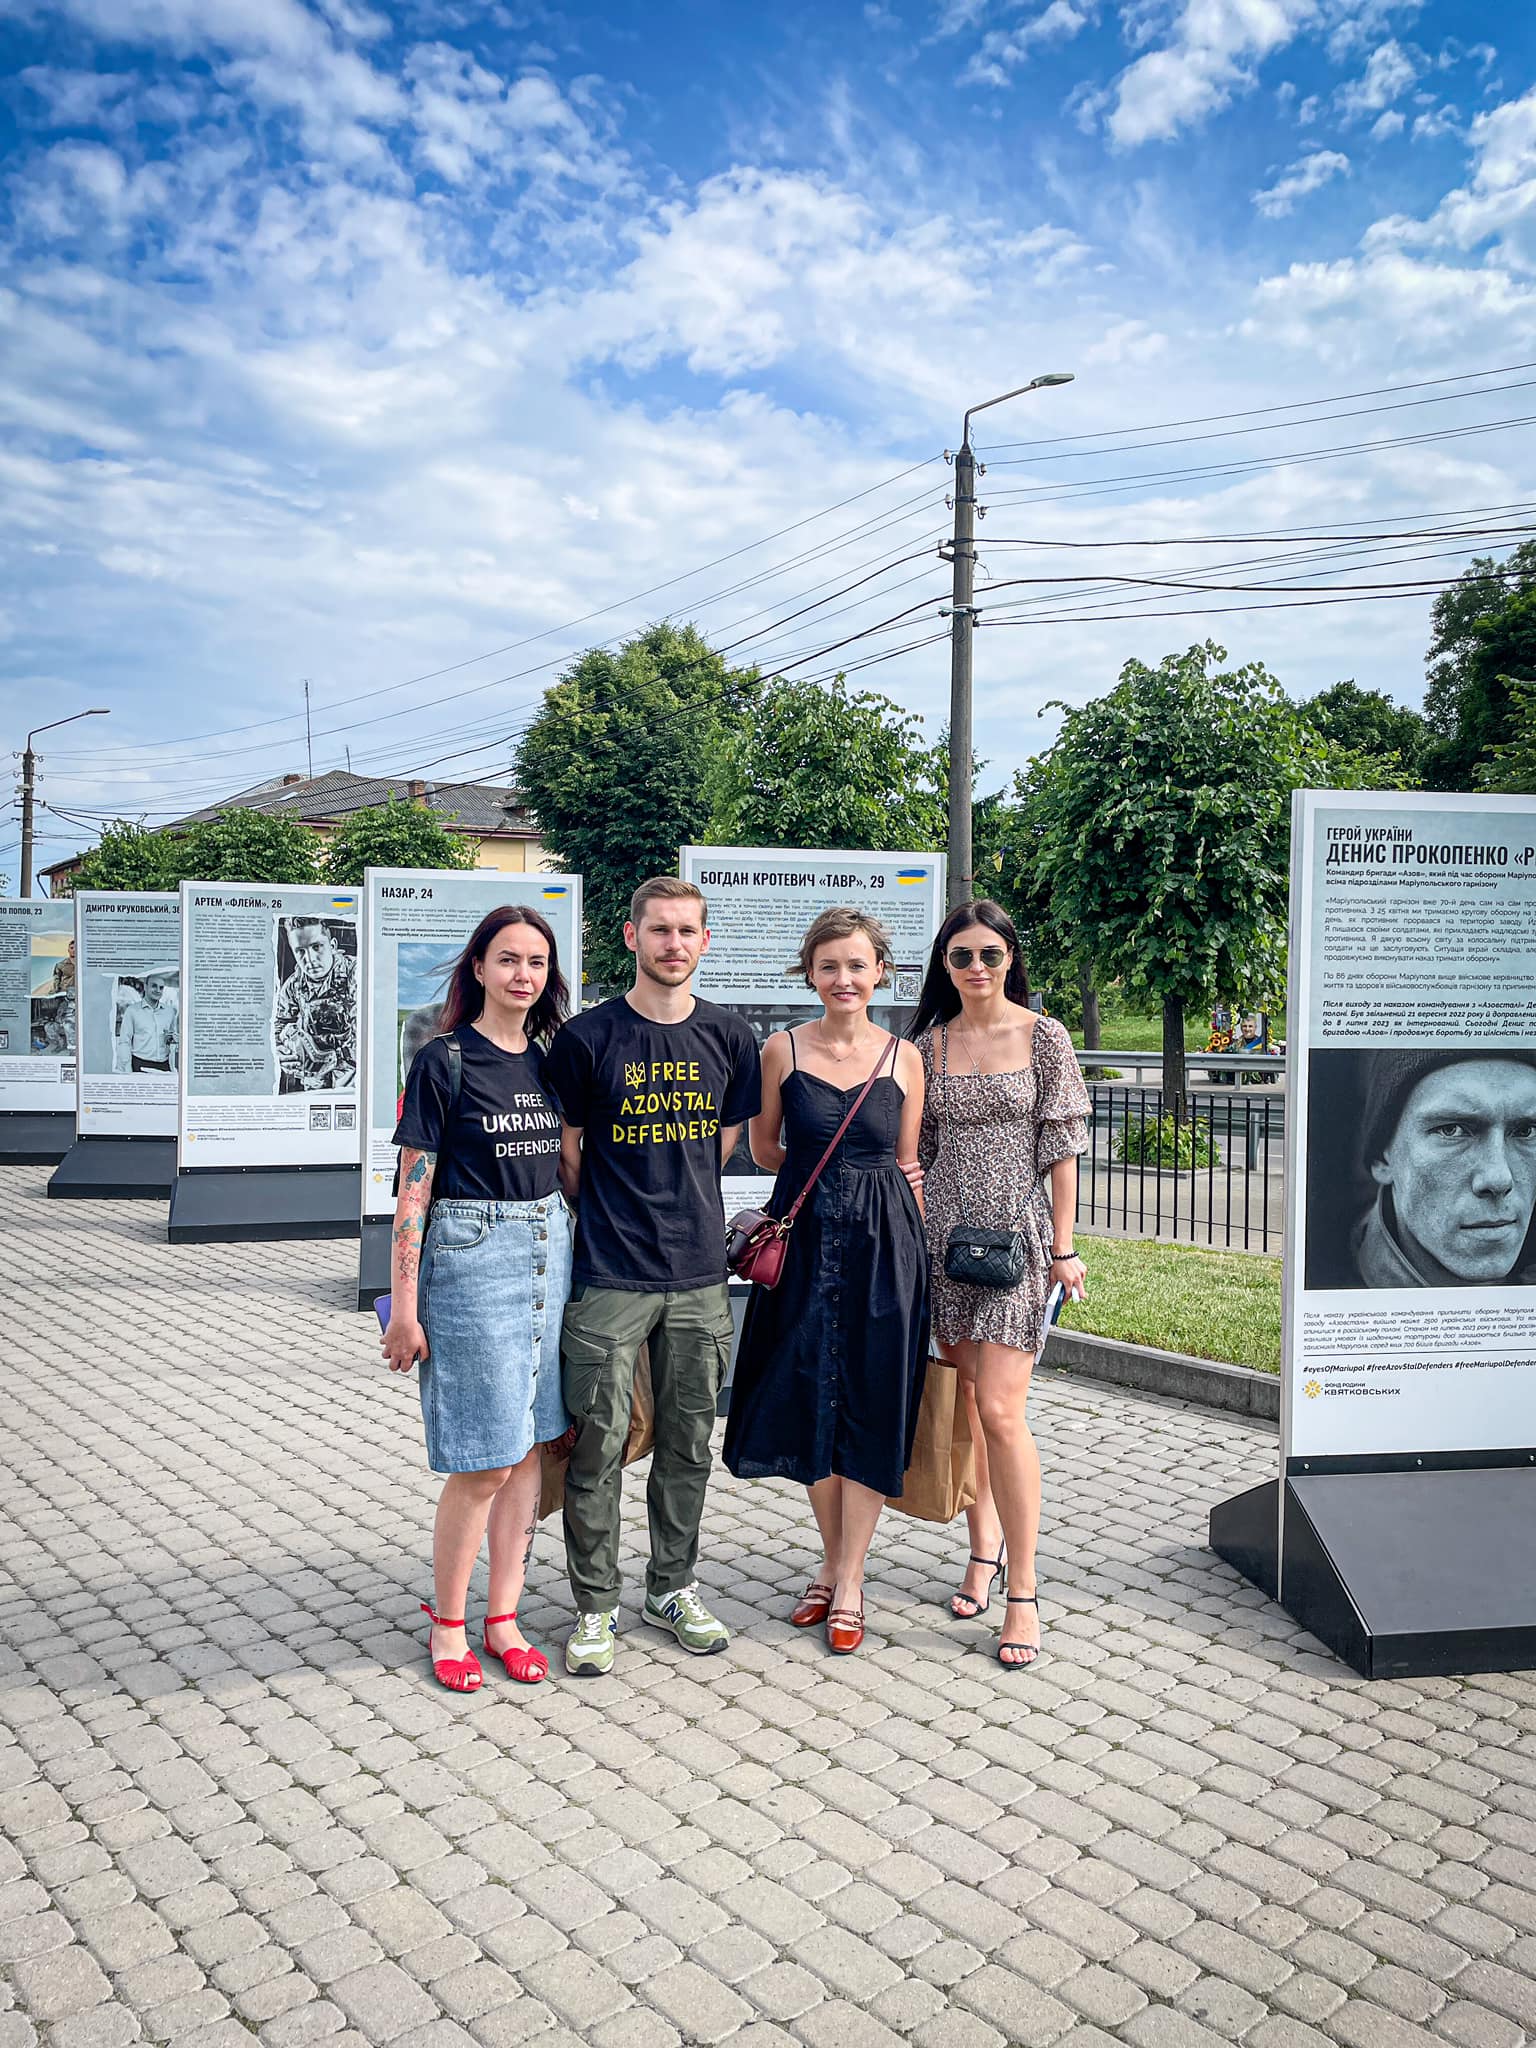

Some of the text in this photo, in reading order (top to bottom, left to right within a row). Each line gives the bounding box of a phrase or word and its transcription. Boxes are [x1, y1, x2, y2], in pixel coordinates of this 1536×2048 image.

[1327, 826, 1412, 842] ГЕРОЙ УКРАЇНИ
[1326, 843, 1536, 866] ДЕНИС ПРОКОПЕНКО «Р
[701, 871, 884, 889] БОГДАН КРОТЕВИЧ «ТАВР», 29
[1326, 869, 1364, 878] Командир
[1366, 869, 1396, 878] бригади
[1448, 870, 1459, 878] під
[1474, 871, 1505, 879] оборони
[1348, 879, 1397, 887] підрозділами
[1399, 880, 1462, 888] Маріупольського
[1463, 880, 1498, 889] гарнізону
[382, 887, 432, 900] НАЗАР, 24
[86, 904, 115, 913] ДМИТРО
[117, 904, 171, 914] КРУКОВСЬКИЙ,
[195, 897, 282, 909] АРТЕМ «ФЛЕЙМ», 26
[1345, 1000, 1371, 1009] виходу
[1417, 1001, 1470, 1009] командування
[1351, 1010, 1364, 1018] Був
[1322, 1029, 1360, 1037] бригадою
[1394, 1029, 1434, 1037] продовжує
[652, 1062, 700, 1082] FREE
[514, 1094, 544, 1108] FREE
[620, 1092, 715, 1115] AZOVSTAL
[612, 1119, 718, 1144] DEFENDERS
[1303, 1365, 1365, 1374] #eyesOfMariupol
[1366, 1362, 1453, 1373] #freeAzovStalDefenders
[663, 1600, 684, 1624] N
